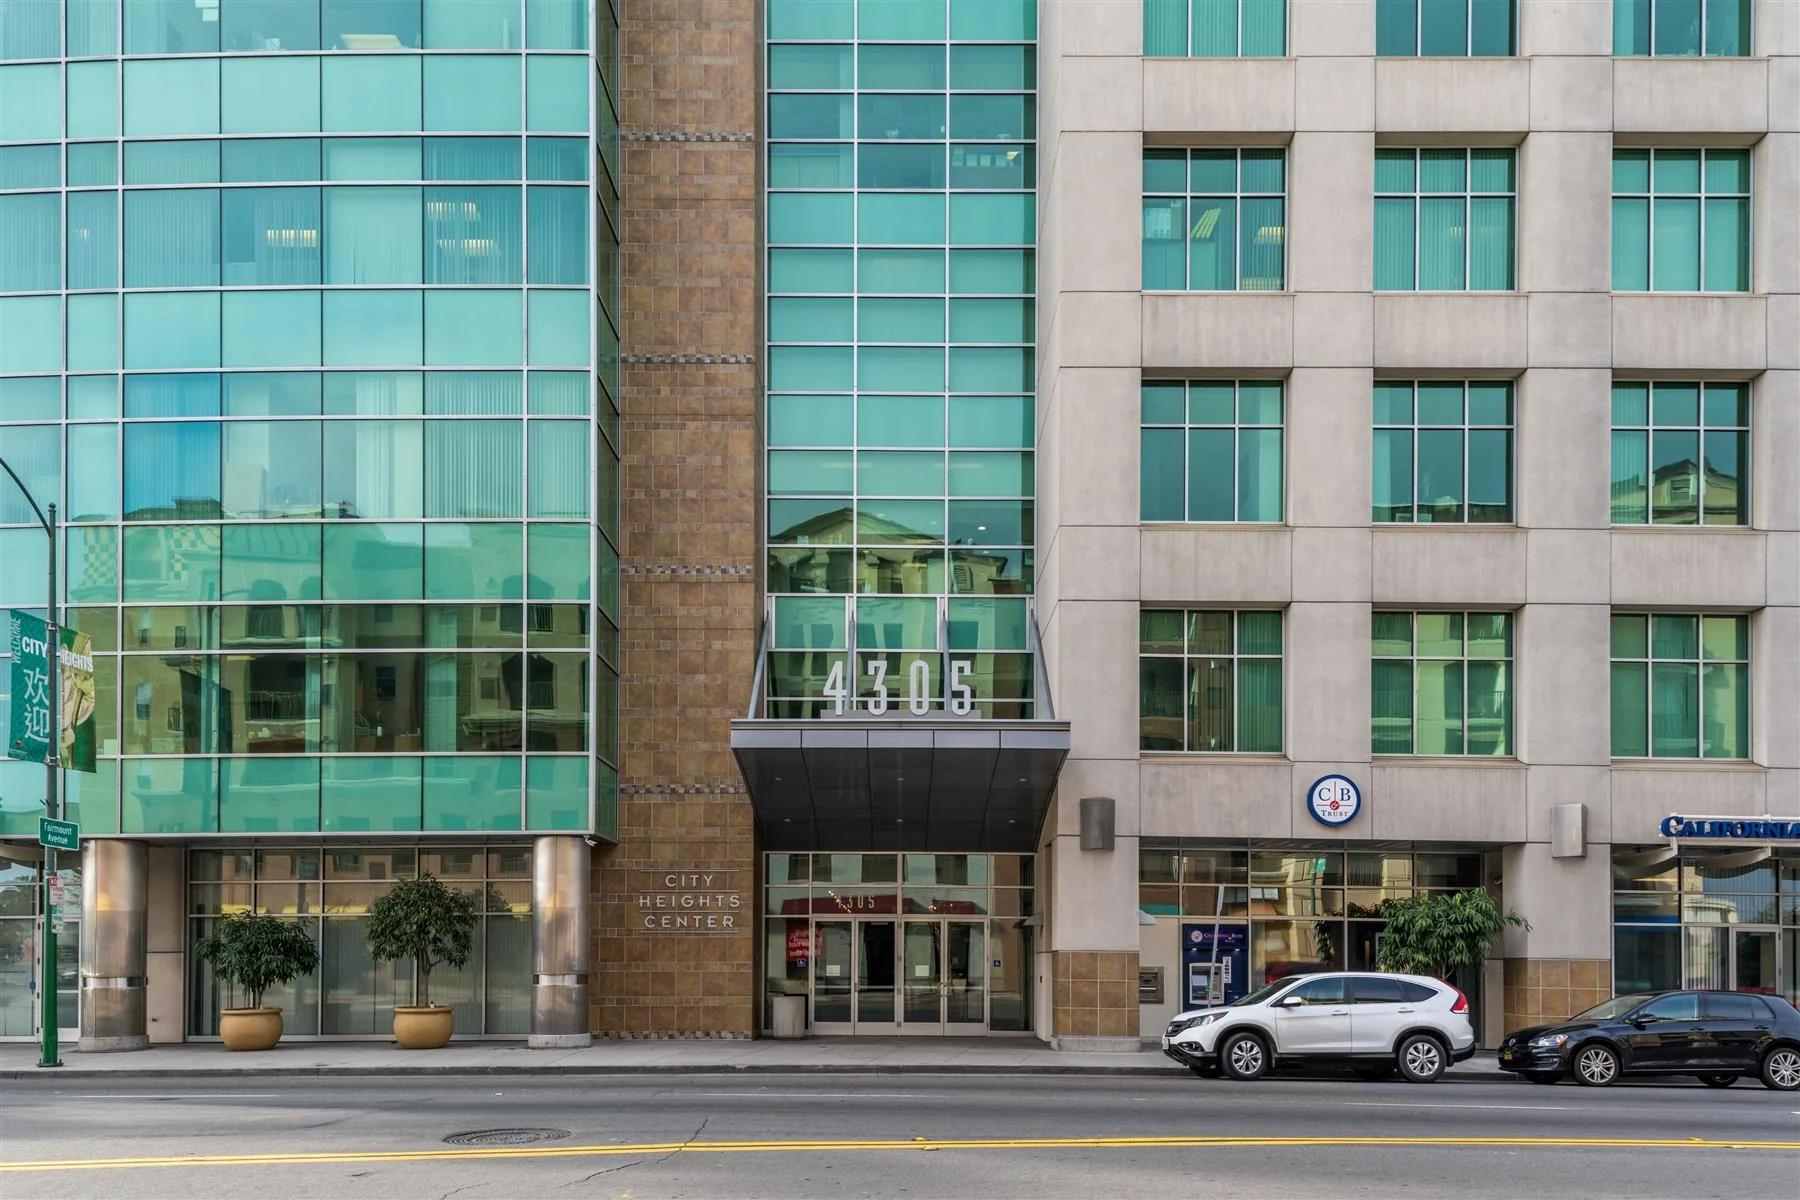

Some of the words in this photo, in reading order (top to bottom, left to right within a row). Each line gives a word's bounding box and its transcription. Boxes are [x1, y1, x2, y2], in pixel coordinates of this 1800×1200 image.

[10, 617, 21, 664] WELCOME
[22, 636, 48, 658] CITY
[60, 650, 93, 672] HEIGHTS
[823, 660, 971, 716] 4305
[23, 667, 49, 743] 欢迎
[1318, 787, 1331, 802] C
[1339, 787, 1351, 802] B
[44, 822, 72, 836] Fairmount
[47, 834, 68, 845] Avenue
[665, 874, 713, 887] CITY
[639, 895, 740, 907] HEIGHTS
[644, 915, 734, 928] CENTER
